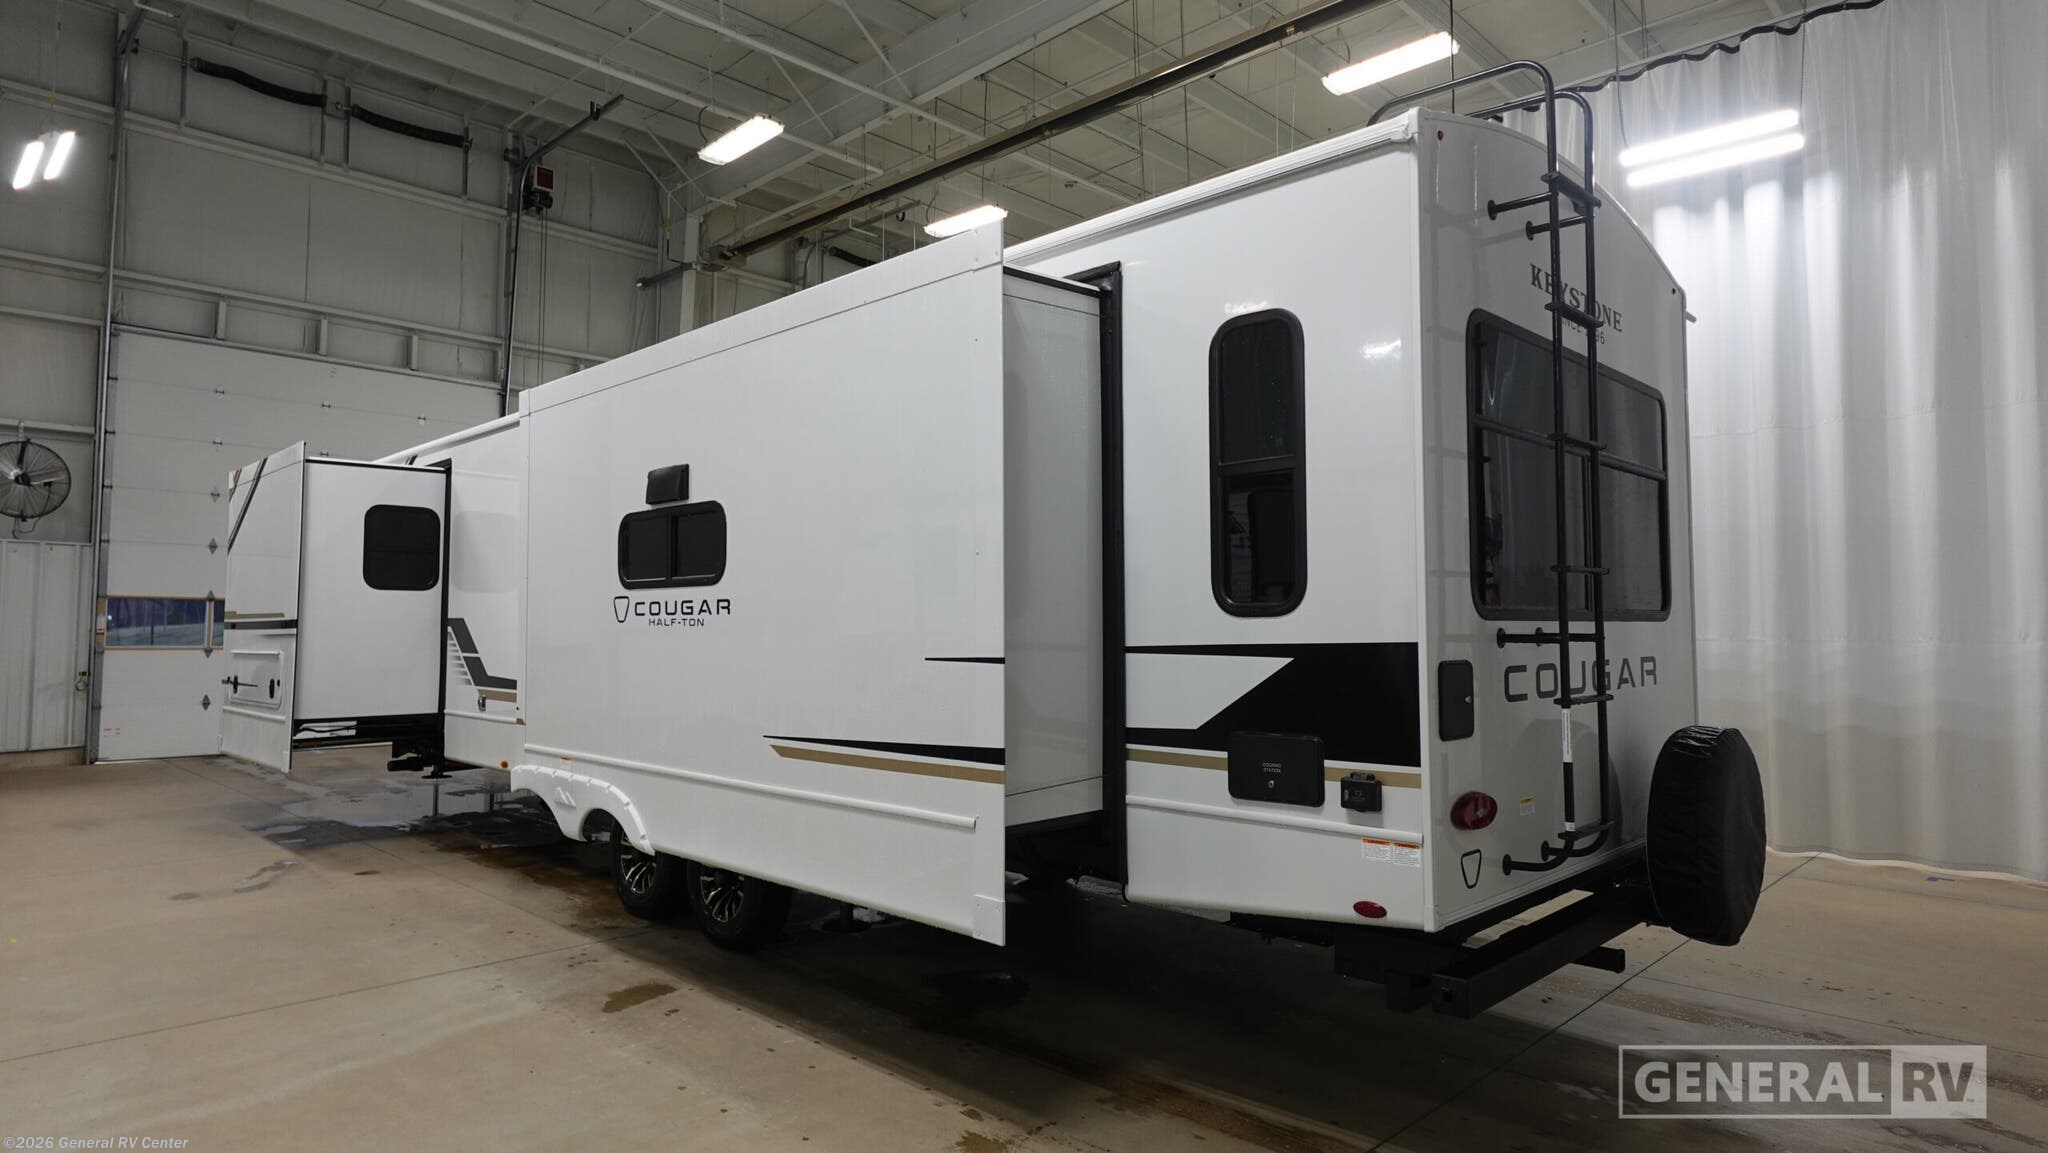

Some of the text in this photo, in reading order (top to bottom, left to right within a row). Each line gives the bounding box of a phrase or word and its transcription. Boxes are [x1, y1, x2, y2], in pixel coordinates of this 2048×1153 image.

[634, 598, 731, 616] COUGAR
[648, 618, 705, 627] HALF-TON
[1503, 656, 1658, 702] COUGAR
